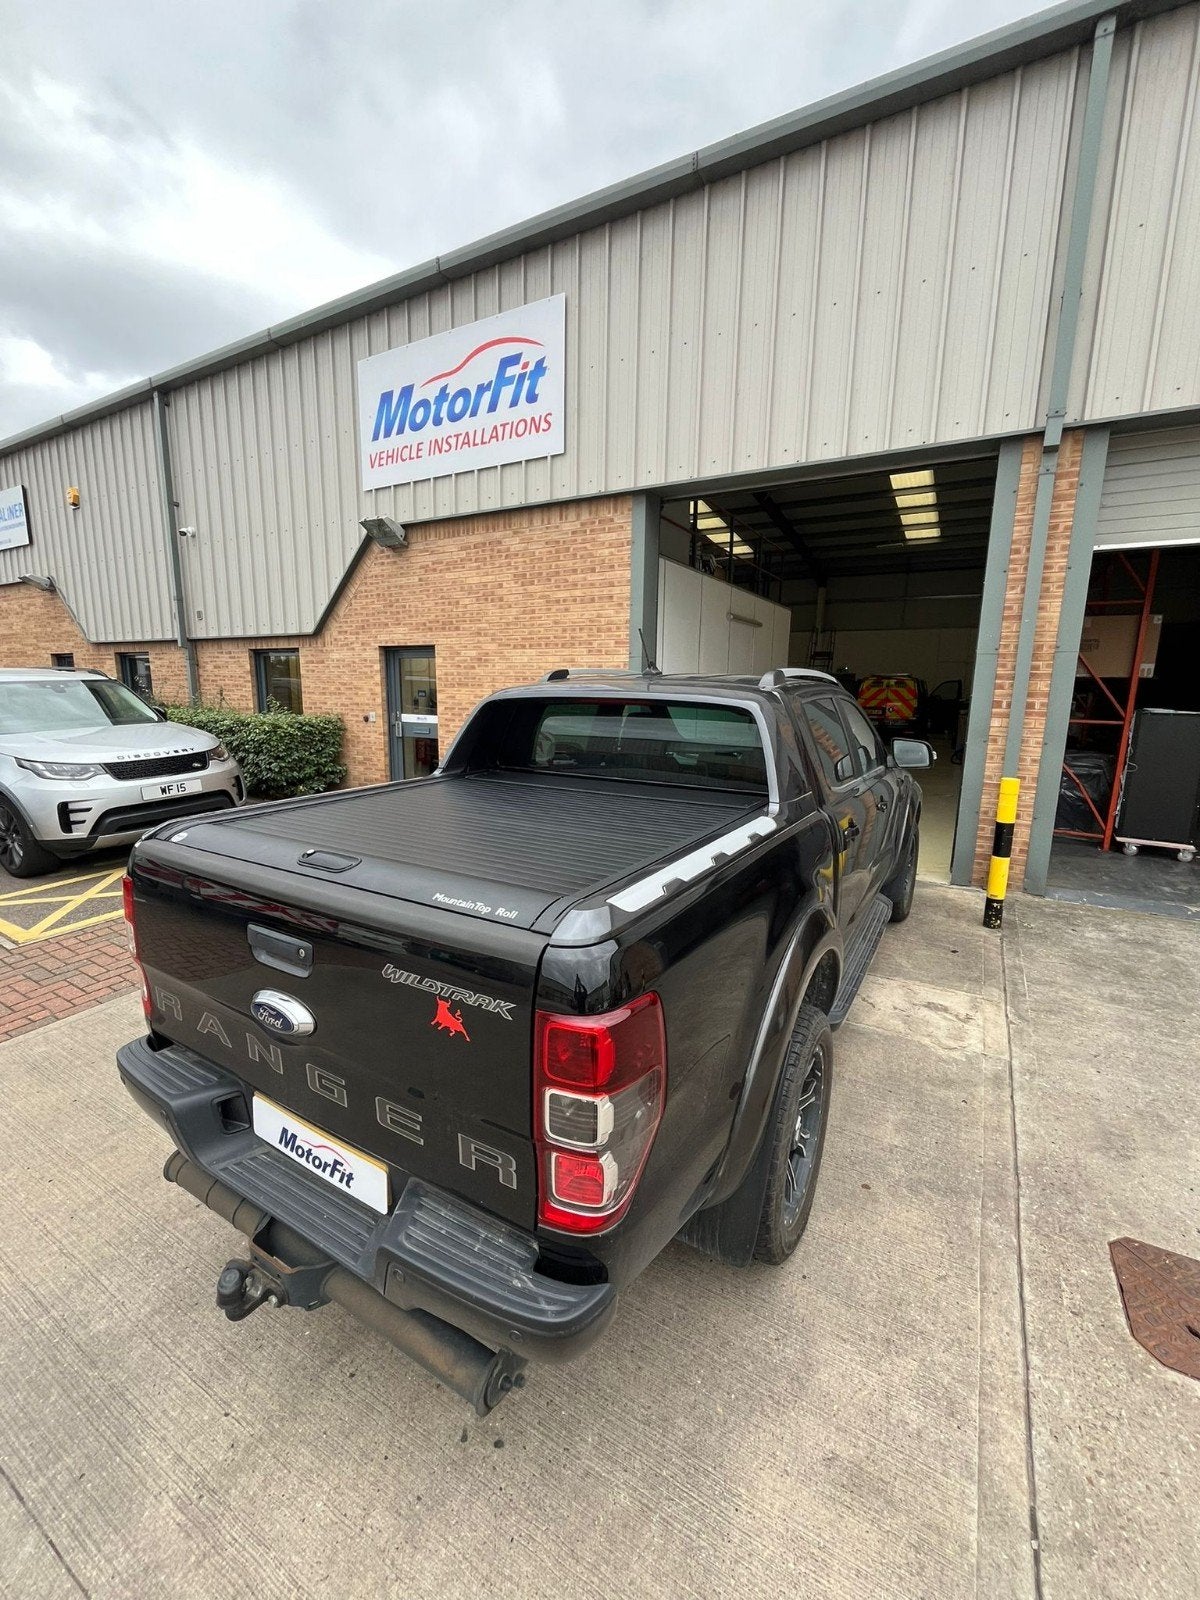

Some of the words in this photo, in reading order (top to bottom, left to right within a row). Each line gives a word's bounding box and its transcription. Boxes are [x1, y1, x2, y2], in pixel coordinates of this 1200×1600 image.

[371, 351, 548, 442] MotorFit
[369, 441, 424, 469] VEHICLE
[428, 412, 553, 456] INSTALLATIONS
[116, 747, 196, 760] DISCOVERY
[160, 784, 174, 796] WF
[495, 907, 519, 919] Roll
[257, 1004, 284, 1029] Ford
[381, 963, 517, 1021] WILDTRAK
[152, 985, 518, 1190] RANGER
[278, 1125, 355, 1189] MotorFit
